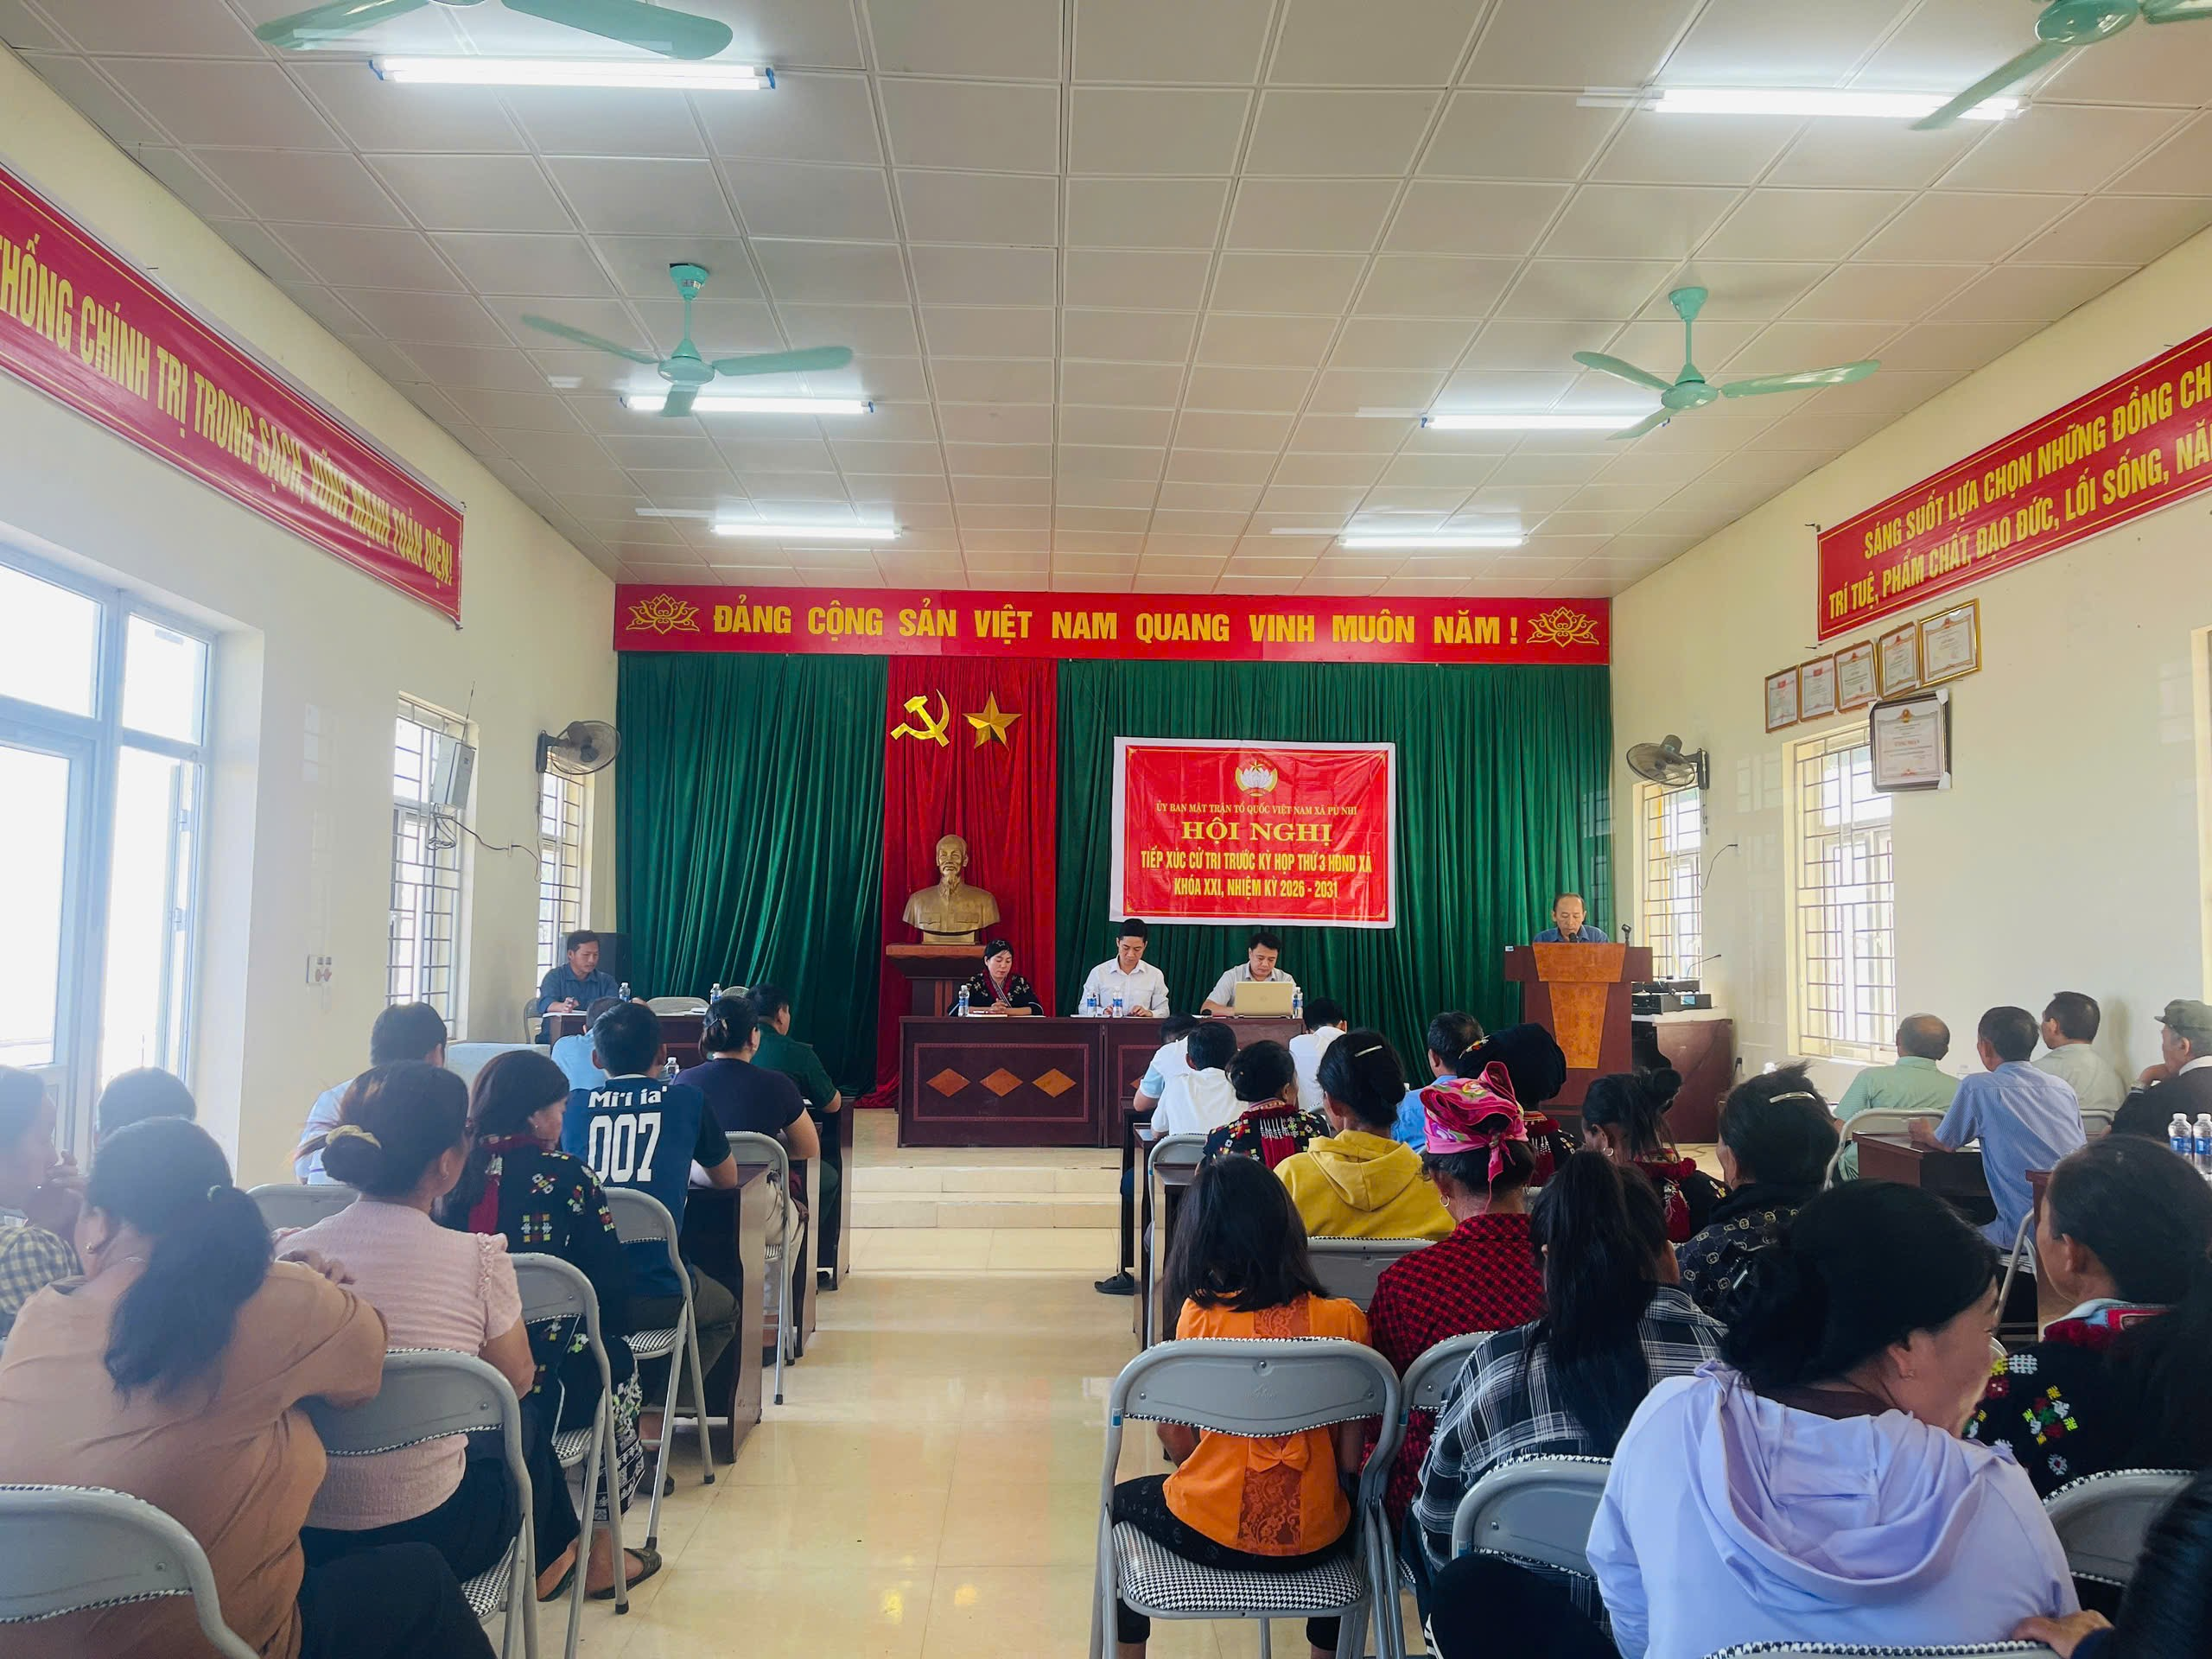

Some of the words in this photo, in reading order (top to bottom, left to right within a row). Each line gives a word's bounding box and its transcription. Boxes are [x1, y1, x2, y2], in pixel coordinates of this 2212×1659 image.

[80, 296, 150, 401] CHÍNH
[156, 345, 188, 438] TRỊ
[194, 371, 254, 464] TRONG
[257, 417, 304, 505] SẠCH,
[392, 507, 423, 569] TOÀN
[425, 527, 453, 589] DIỆN!
[1865, 523, 1903, 560] SÁNG
[1906, 488, 1944, 540] SUỐT
[1948, 481, 1979, 520] LỰA
[1984, 455, 2031, 503] CHỌN
[2037, 416, 2107, 479] NHỮNG
[2112, 382, 2172, 443] ĐỒNG
[1828, 582, 1849, 620] TRÍ
[1851, 570, 1879, 611] TUỆ,
[1882, 548, 1924, 598] PHẨM
[1929, 527, 1972, 575] CHẤT,
[1976, 517, 2012, 562] ĐẠO
[2015, 497, 2060, 541] ĐỨC,
[2064, 467, 2096, 522] LỐI
[2102, 448, 2170, 505] SỐNG,
[2176, 418, 2212, 474] NĂ
[714, 594, 791, 633] ĐẢNG
[808, 601, 883, 641] CỘNG
[899, 597, 957, 637] SẢN
[974, 604, 1033, 644] VIỆT
[1052, 613, 1118, 639] NAM
[1135, 613, 1230, 644] QUANG
[1249, 614, 1314, 643] VINH
[1332, 608, 1415, 644] MUÔN
[1433, 609, 1500, 645] NĂM
[1510, 616, 1518, 645] !
[1170, 804, 1187, 812] BAN
[1234, 801, 1245, 813] TỔ
[1247, 801, 1270, 815] QUỐC
[1272, 804, 1292, 816] VIỆT
[1294, 806, 1313, 815] NAM
[1341, 806, 1357, 816] NHI
[1181, 817, 1240, 844] HỘI
[1249, 823, 1332, 847] NGHỊ
[1141, 845, 1163, 868] TIẾP
[1166, 847, 1186, 869] XÚC
[1189, 846, 1205, 869] CỬ
[1205, 852, 1221, 869] TRI
[1224, 849, 1255, 870] TRƯỚC
[1258, 849, 1271, 871] KỲ
[1274, 853, 1295, 874] HỌP
[1298, 850, 1319, 872] THỨ
[1319, 854, 1325, 872] 3
[1328, 855, 1356, 873] HĐND
[1174, 874, 1202, 896] KHÓA
[1204, 878, 1224, 897] XXI,
[1227, 875, 1262, 900] NHIỆM
[1264, 875, 1278, 897] KỲ
[1280, 880, 1306, 898] 2026
[1314, 880, 1338, 899] 2031
[588, 1112, 661, 1184] 007
